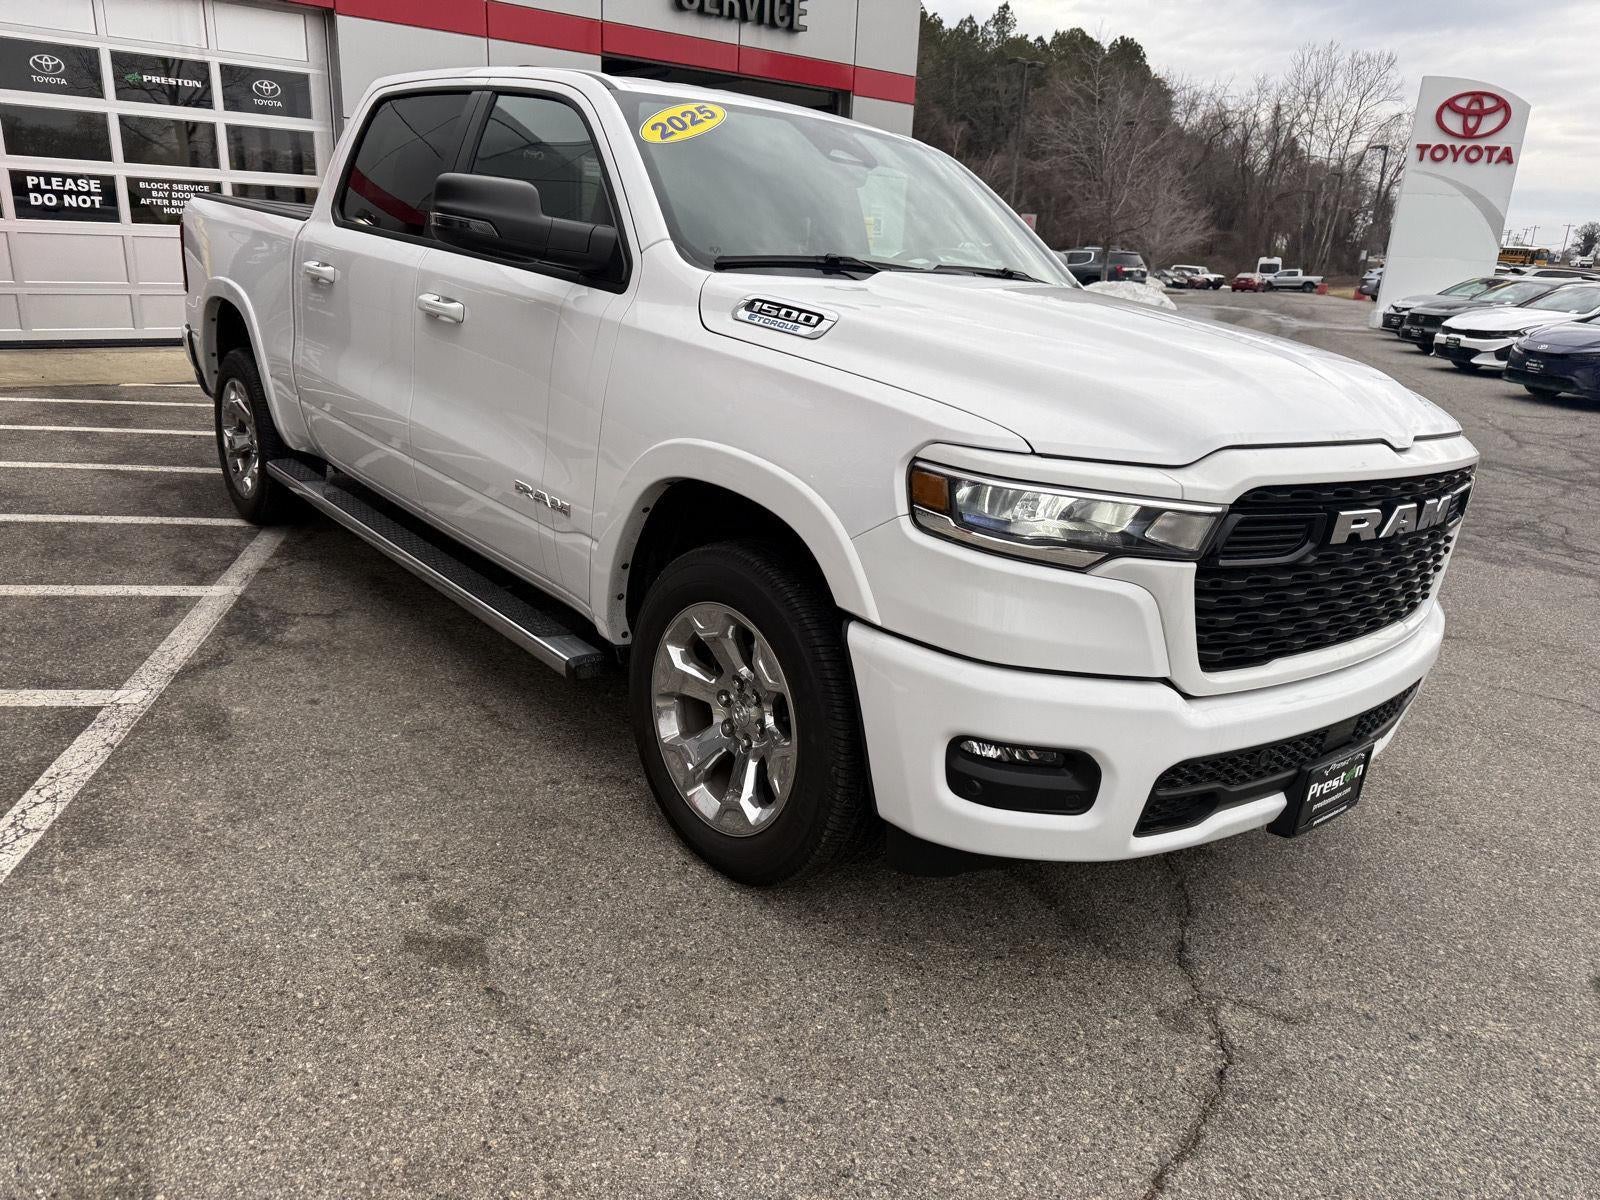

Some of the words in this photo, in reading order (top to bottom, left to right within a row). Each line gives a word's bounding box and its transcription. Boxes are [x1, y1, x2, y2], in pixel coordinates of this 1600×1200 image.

[672, 0, 808, 32] VICE
[31, 75, 67, 85] TOYOTA
[142, 74, 202, 88] PRESTON
[253, 98, 283, 108] TOYOTA
[650, 104, 717, 141] 2025
[1416, 143, 1514, 164] TOYOTA
[26, 175, 102, 192] PLEASE
[139, 181, 170, 190] BLOCK
[172, 183, 210, 193] SERVICE
[29, 192, 57, 206] DO
[63, 194, 103, 209] NOT
[140, 198, 170, 206] AFTER
[151, 190, 170, 198] BAY
[751, 301, 819, 326] 1500
[1329, 494, 1452, 545] RAM
